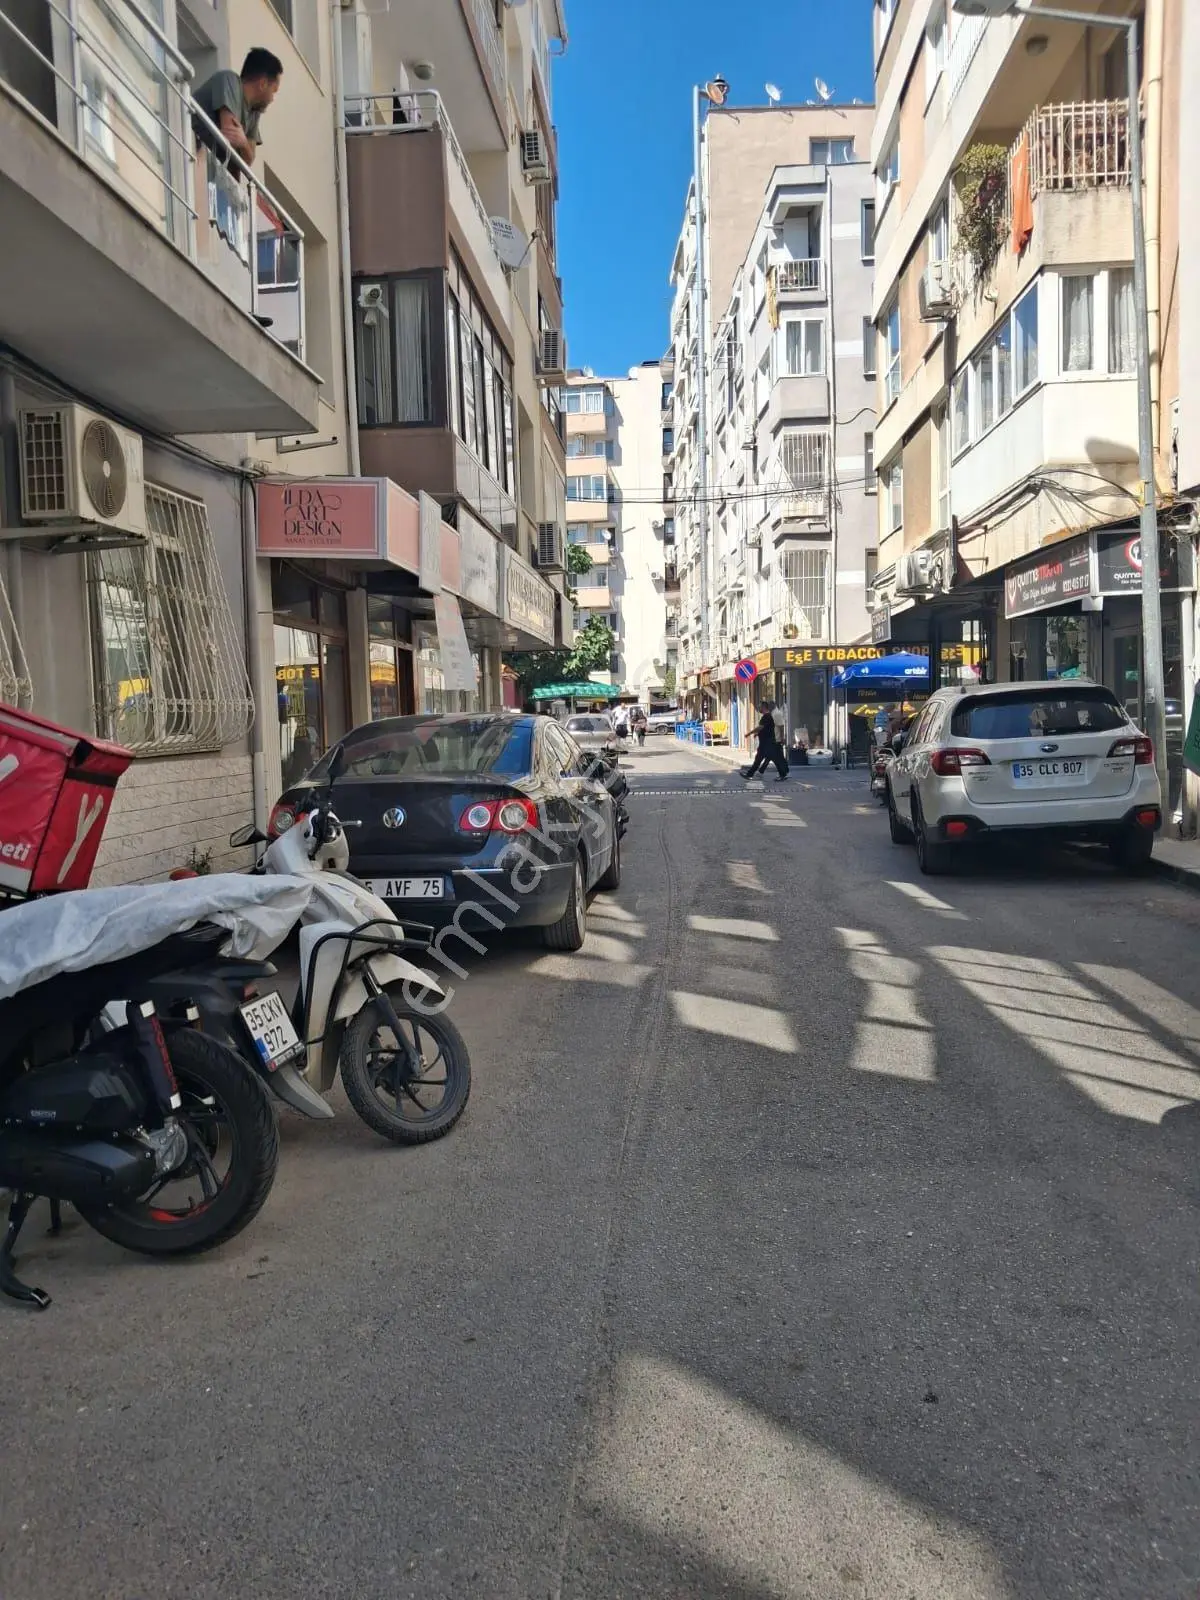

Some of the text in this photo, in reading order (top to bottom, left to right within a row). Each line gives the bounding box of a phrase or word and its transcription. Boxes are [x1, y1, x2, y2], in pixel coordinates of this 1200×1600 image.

[284, 519, 342, 536] DESIGN
[815, 646, 885, 662] TOBACCO
[1020, 761, 1083, 777] 35 CLC 807
[385, 880, 412, 896] AVF
[423, 880, 440, 896] 75
[245, 1007, 264, 1031] 35
[263, 1026, 288, 1052] 972
